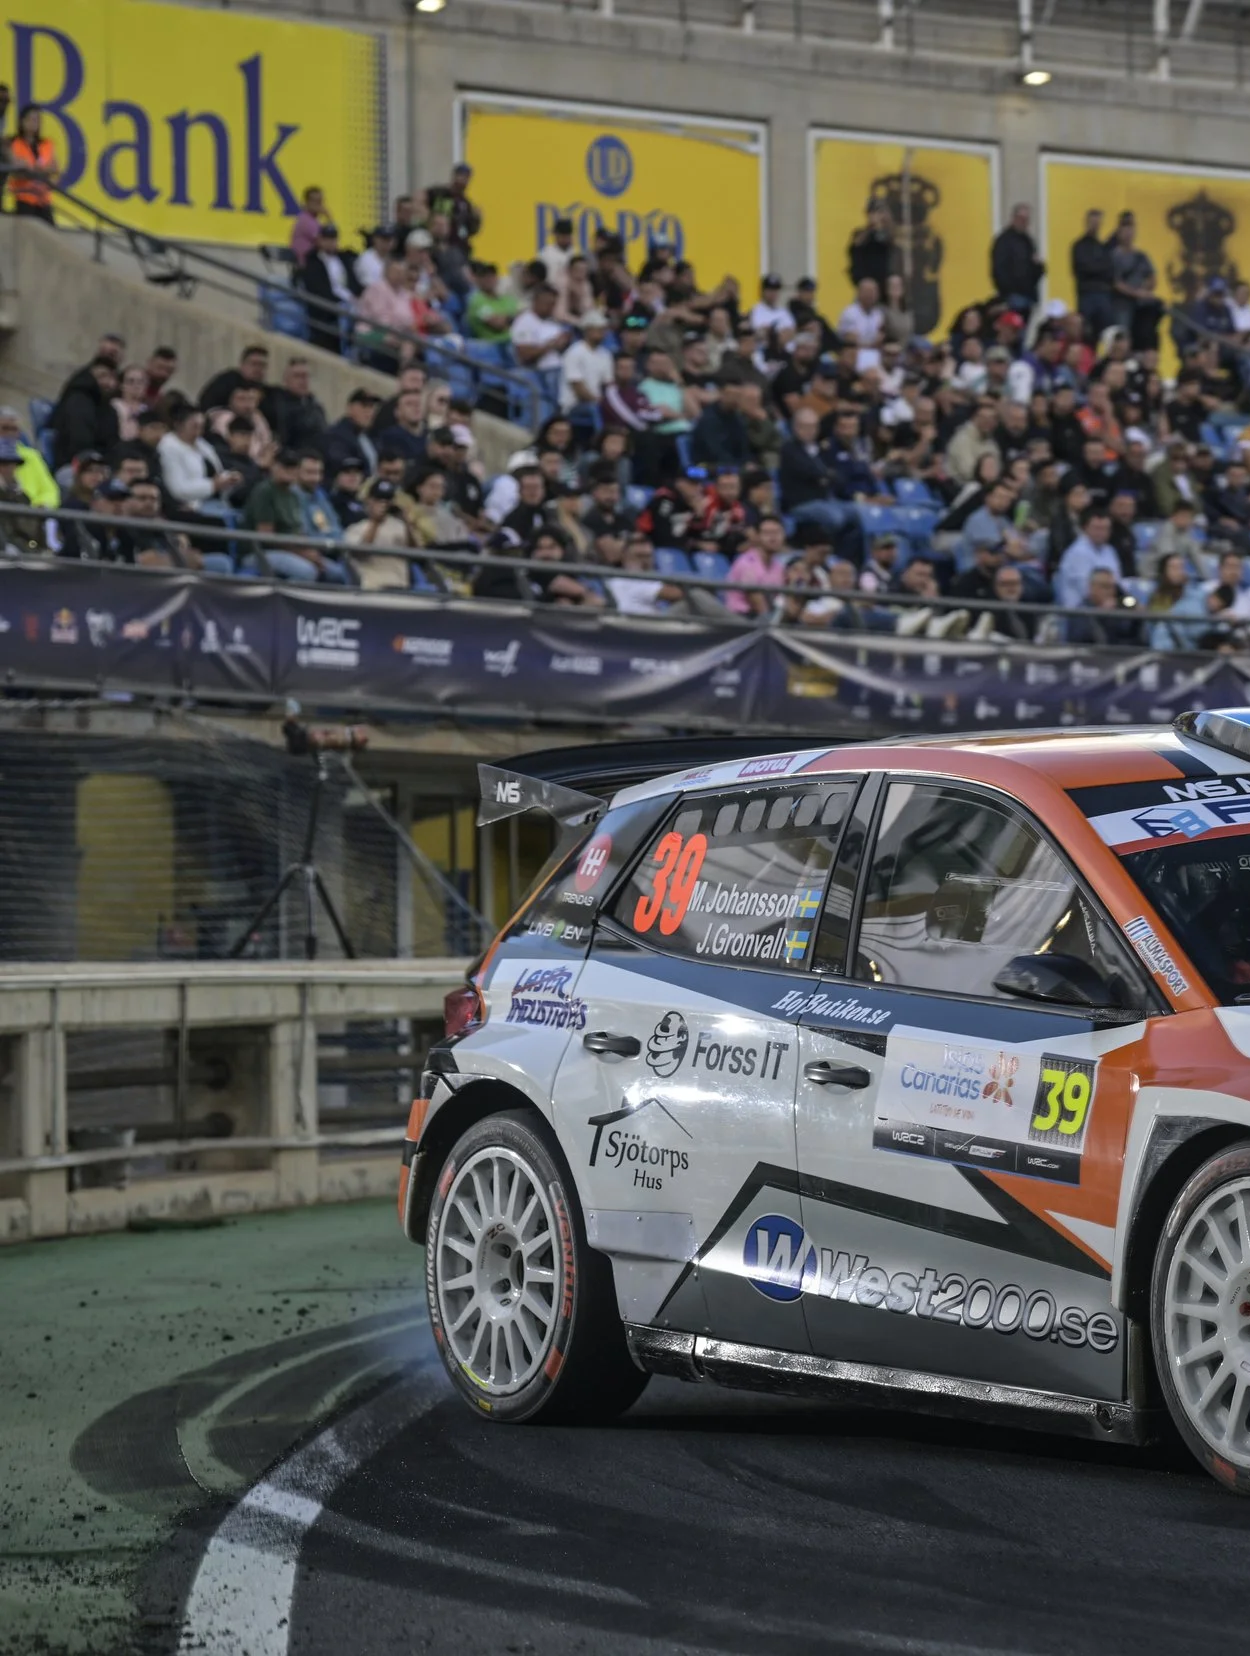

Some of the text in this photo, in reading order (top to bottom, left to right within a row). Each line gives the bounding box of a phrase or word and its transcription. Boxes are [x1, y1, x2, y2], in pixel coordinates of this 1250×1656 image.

[9, 22, 302, 216] Bank
[744, 755, 788, 773] MOTUL
[633, 832, 708, 936] 39
[687, 880, 799, 919] M.Johansson
[696, 922, 787, 960] J.Gronvall
[1141, 933, 1188, 997] ALMASPORT
[692, 1033, 789, 1080] Forss IT
[900, 1063, 981, 1100] Canarias
[1033, 1068, 1090, 1135] 39
[604, 1129, 689, 1177] Sjötorps
[633, 1167, 662, 1190] Hus
[818, 1247, 1119, 1352] West2000.se
